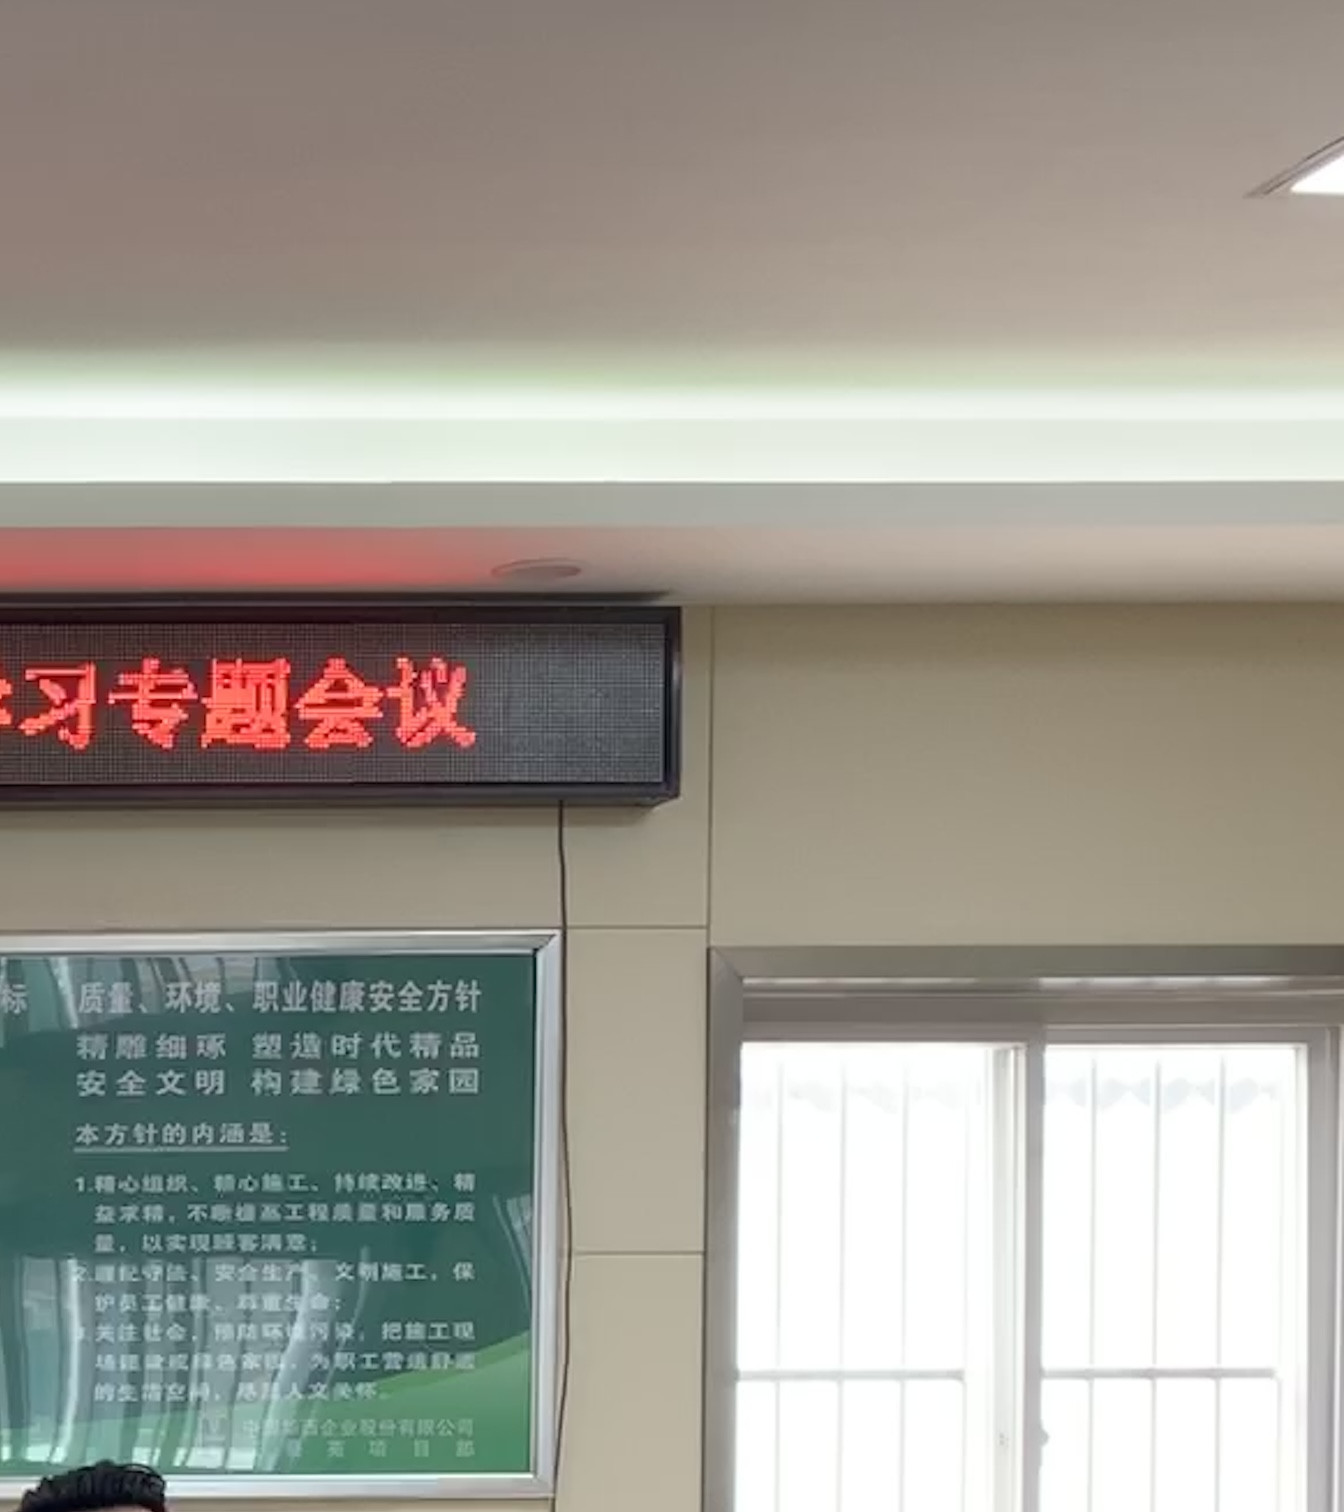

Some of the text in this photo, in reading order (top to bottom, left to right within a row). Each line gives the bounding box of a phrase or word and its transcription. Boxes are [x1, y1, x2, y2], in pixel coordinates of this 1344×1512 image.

[78, 979, 482, 1014] 质量、环境、职业健康安全方针
[76, 1032, 480, 1061] 精雕细琢 塑造时代精品
[76, 1067, 480, 1096] 安全文明 构建绿色家园
